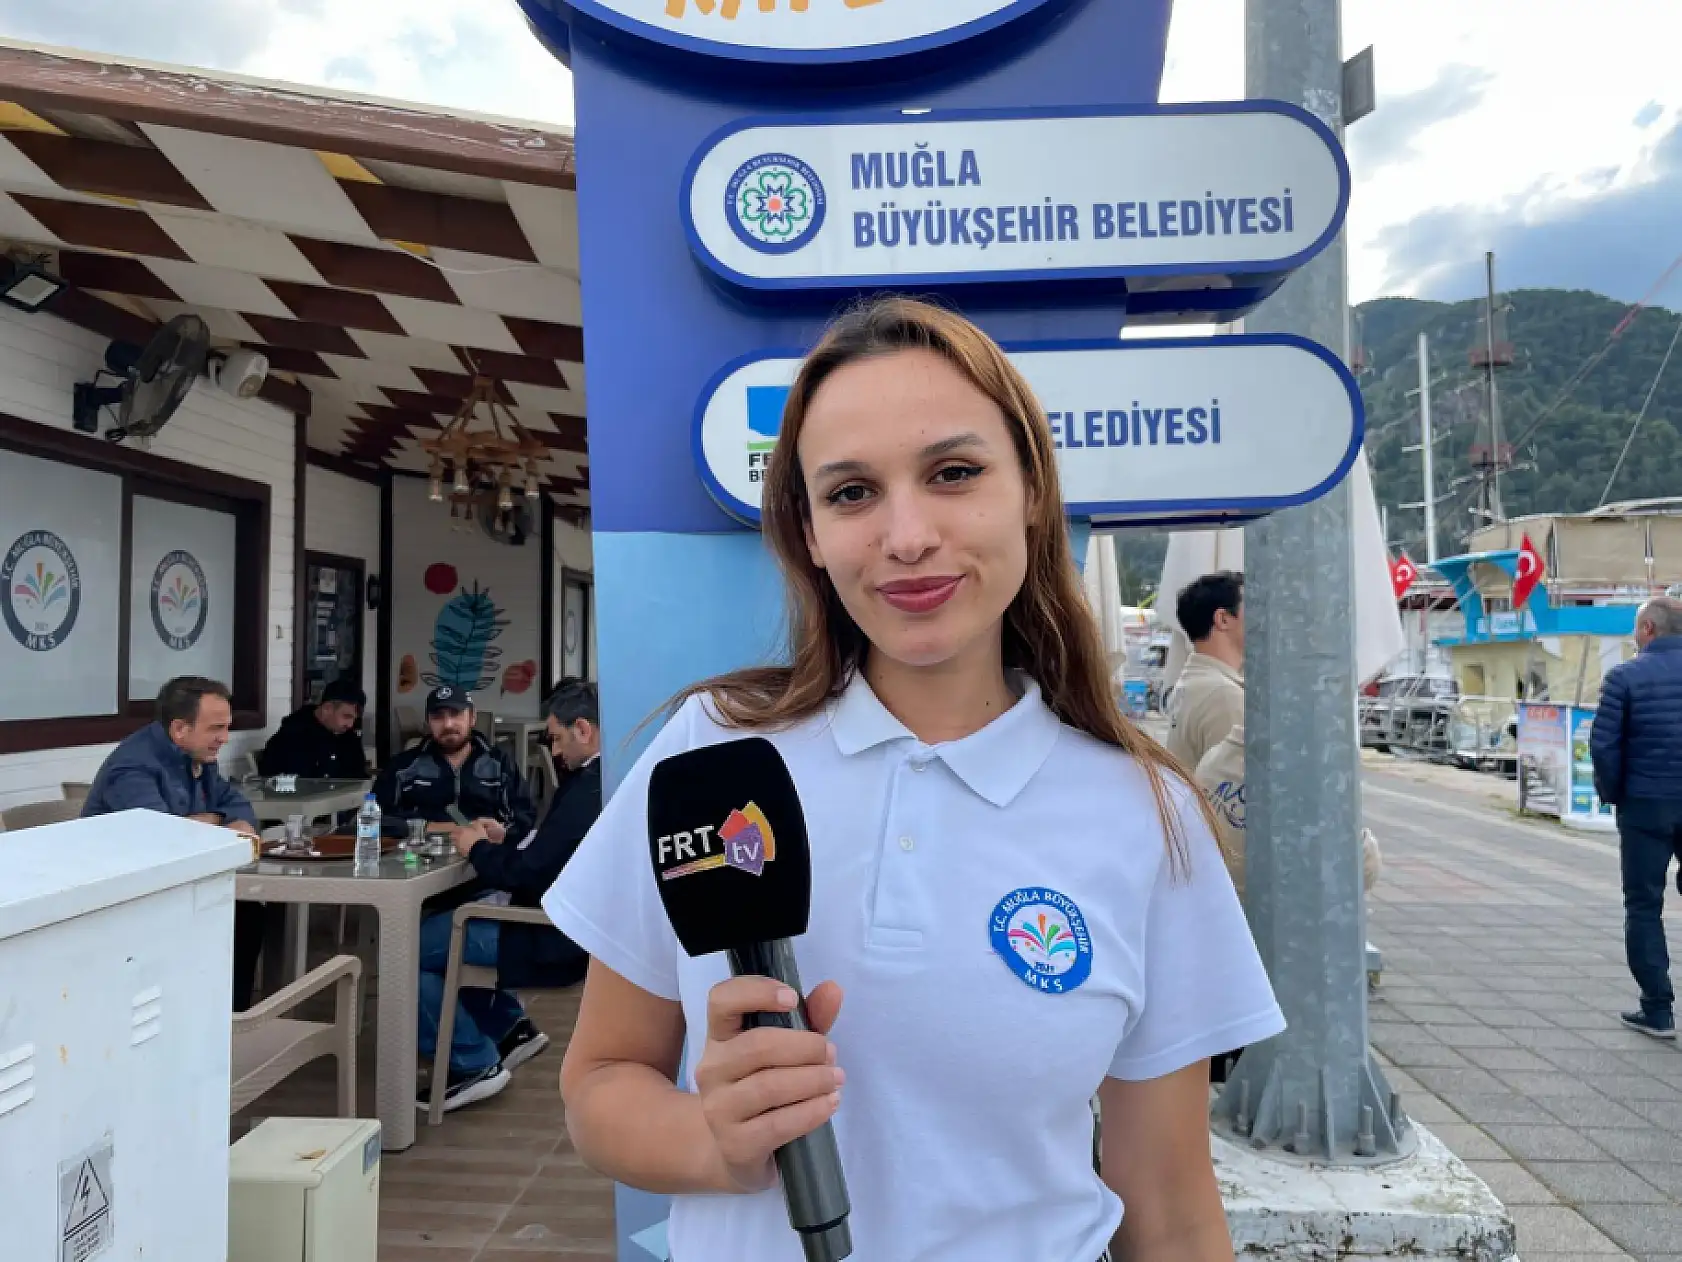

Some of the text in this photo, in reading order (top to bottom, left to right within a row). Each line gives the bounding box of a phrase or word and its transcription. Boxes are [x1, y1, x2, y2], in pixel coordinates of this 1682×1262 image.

[850, 141, 982, 190] MUĞLA
[853, 187, 1294, 250] BÜYÜKŞEHİR BELEDİYESİ
[1047, 398, 1221, 449] ELEDİYESİ
[658, 824, 759, 864] FRT tv
